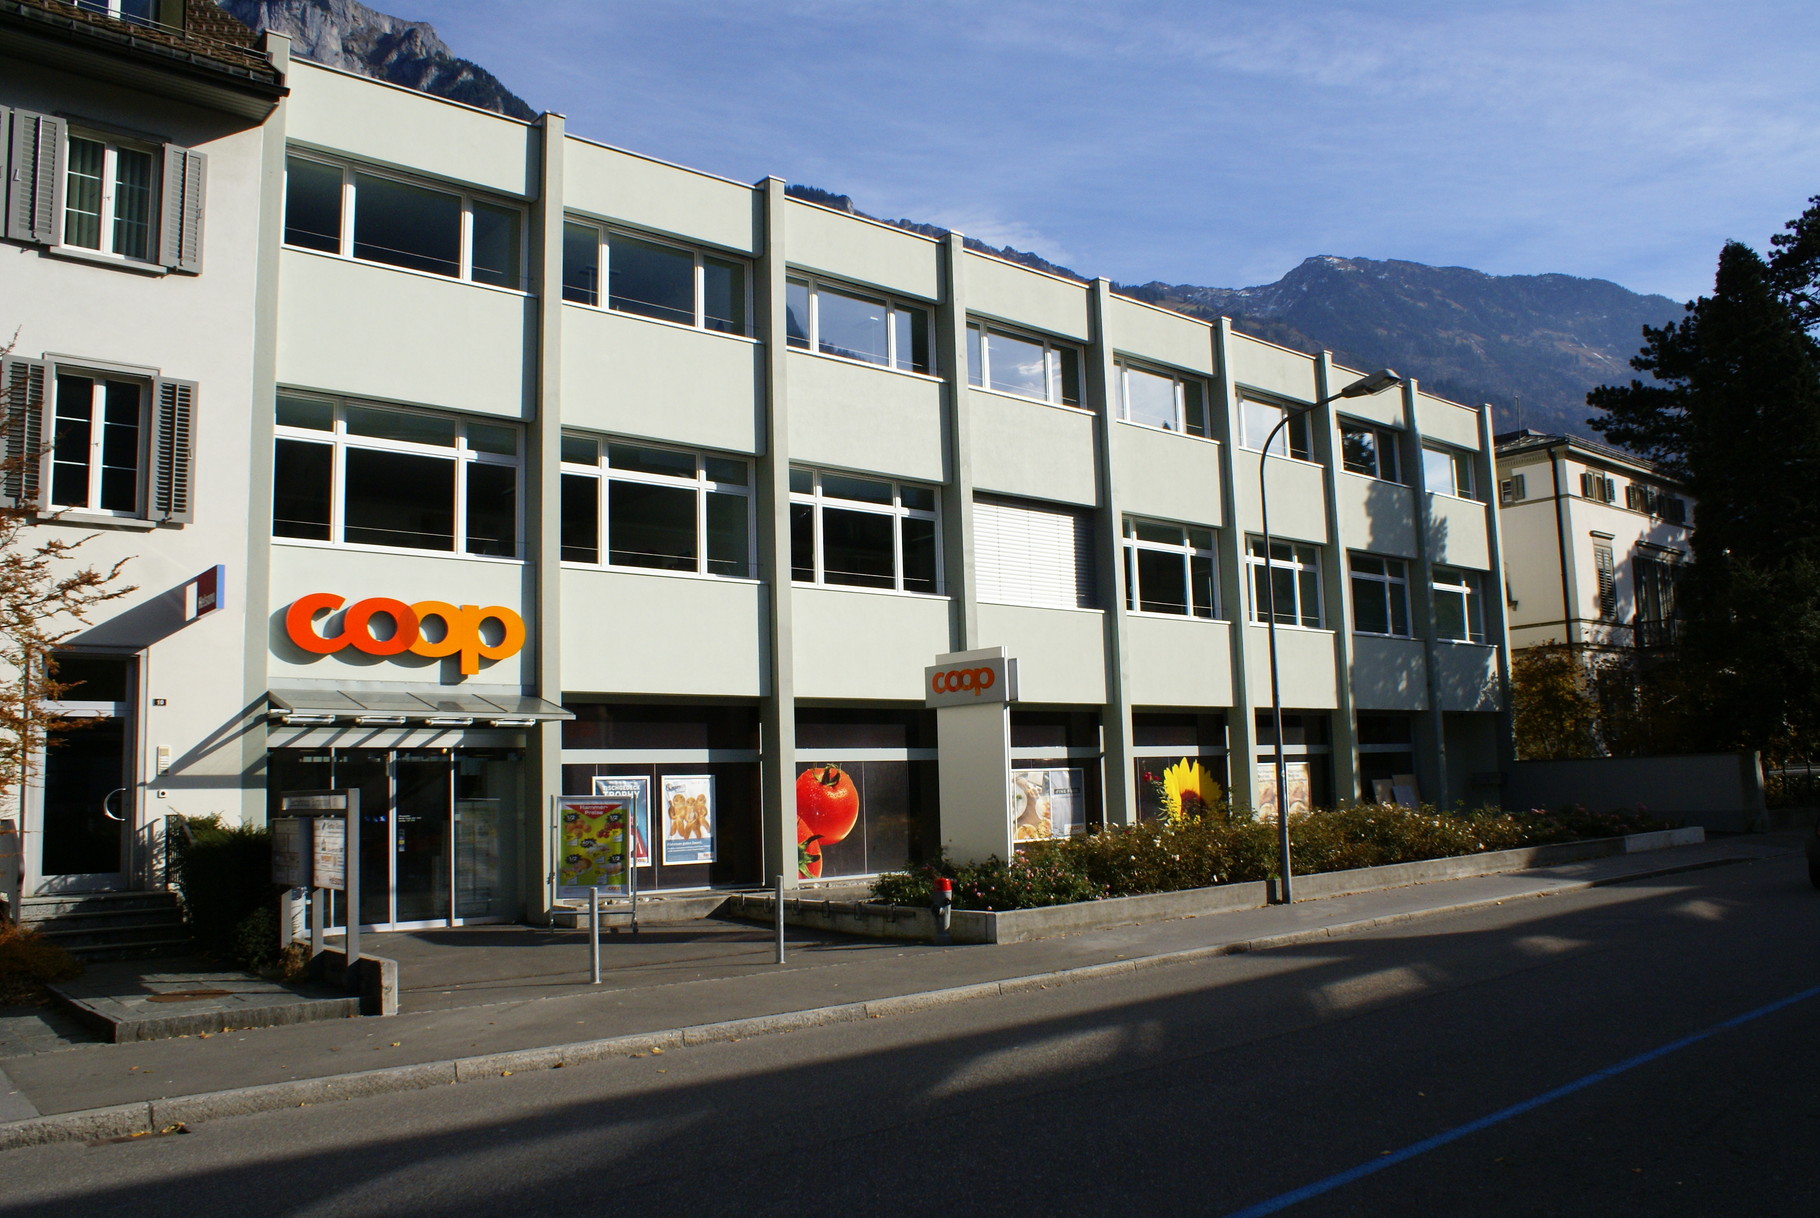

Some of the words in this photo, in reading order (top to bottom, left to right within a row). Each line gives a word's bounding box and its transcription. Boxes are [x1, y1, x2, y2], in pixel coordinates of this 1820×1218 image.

[286, 593, 526, 675] coop
[932, 667, 995, 696] coop
[604, 790, 640, 799] TROPHY
